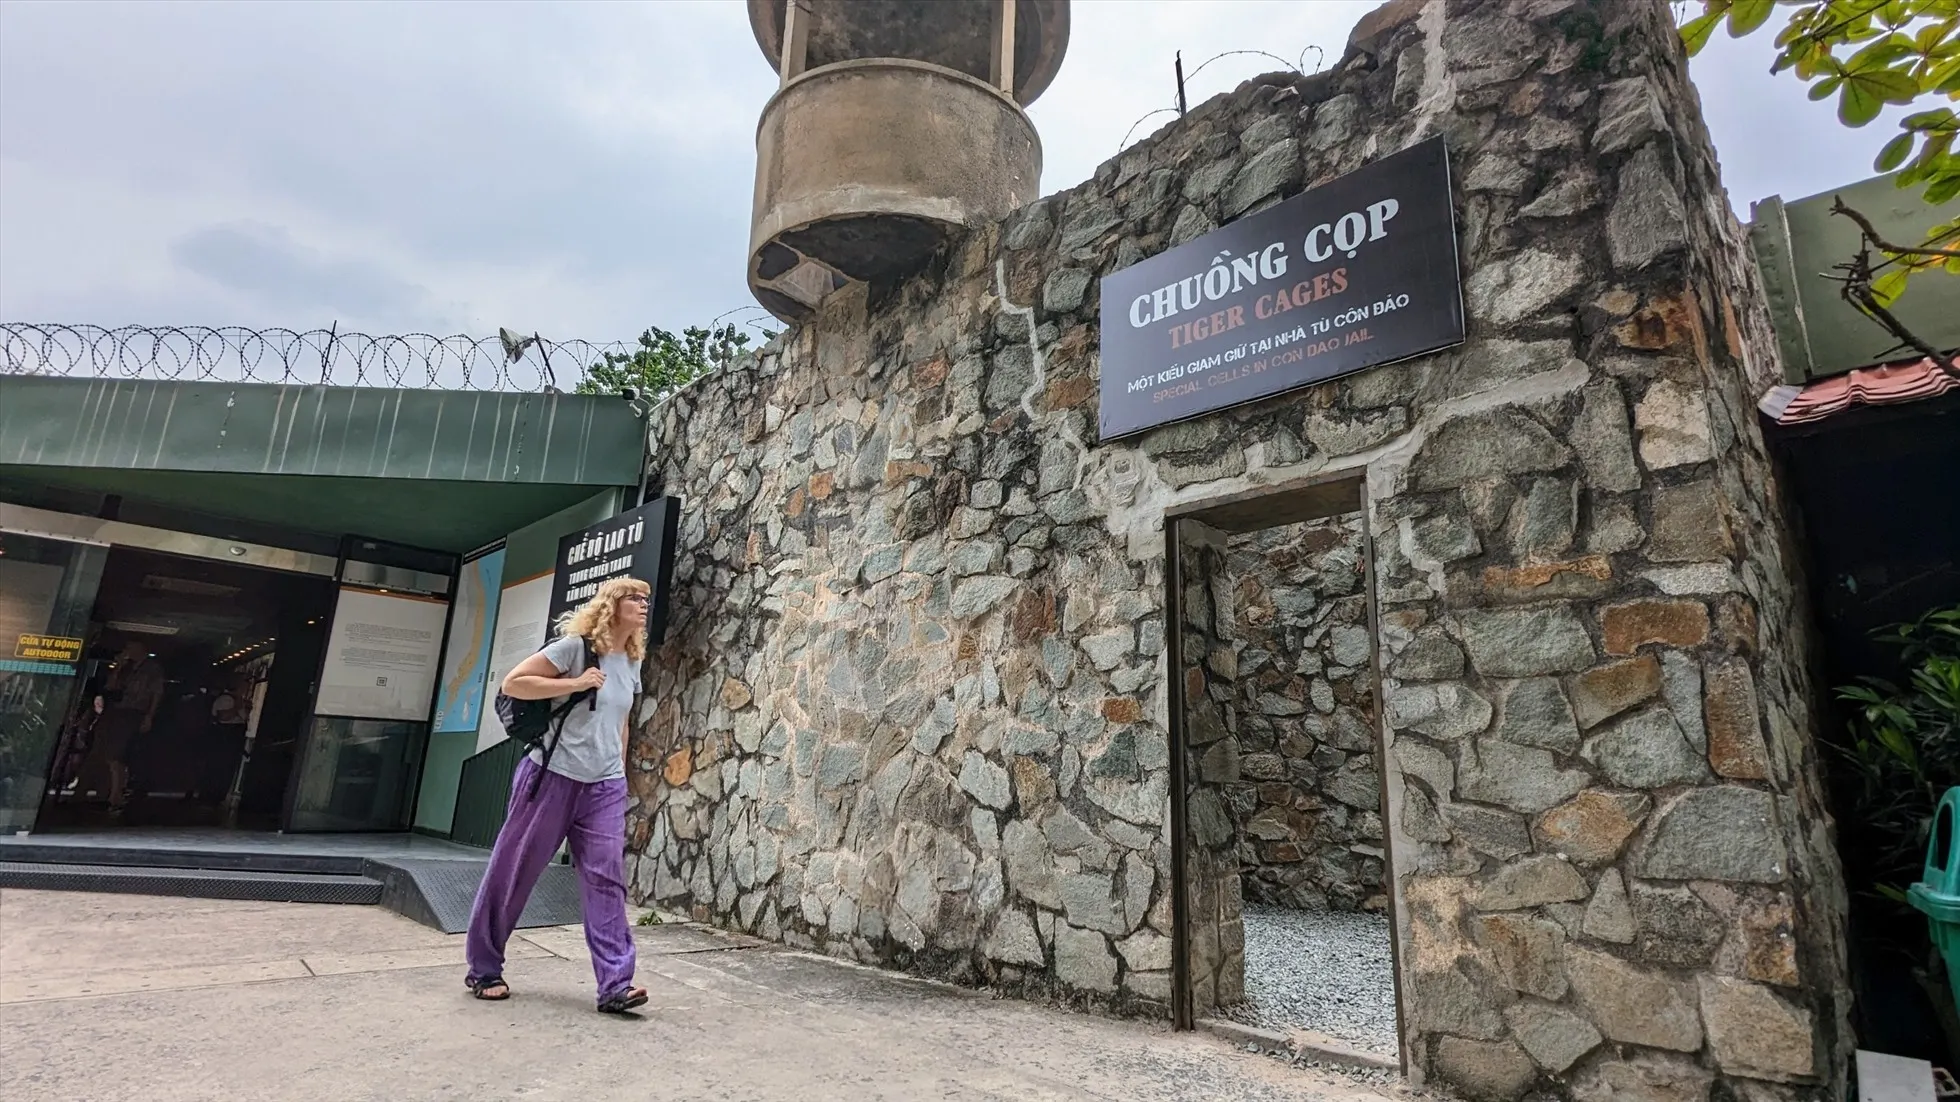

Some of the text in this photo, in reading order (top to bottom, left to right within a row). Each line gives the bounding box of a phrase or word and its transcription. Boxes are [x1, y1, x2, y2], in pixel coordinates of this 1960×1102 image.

[1129, 198, 1400, 329] CHUỒNG CỌP
[1127, 293, 1410, 394] MỘT KIỂU GIAM GIỮ TẠI NHÀ TÙ CÔN ĐẢO
[1168, 267, 1349, 349] TIGER CAGES
[1152, 380, 1203, 404] SPECIAL
[1207, 364, 1251, 387] CELLS
[1253, 359, 1268, 373] IN
[1307, 338, 1340, 357] DAO
[1344, 327, 1375, 347] JAIL
[603, 528, 627, 553] LAO
[23, 647, 71, 659] AUTODOOR
